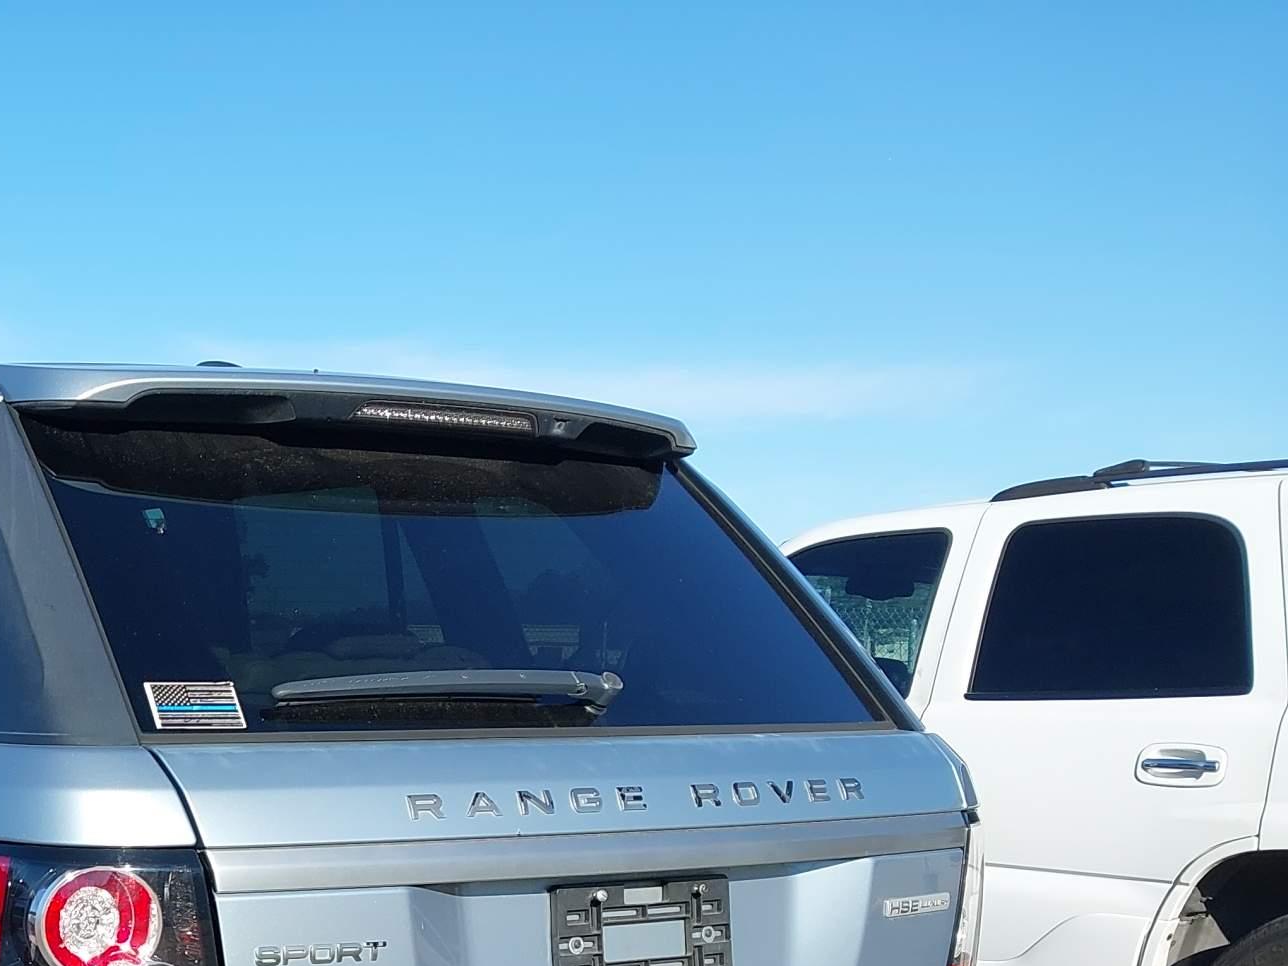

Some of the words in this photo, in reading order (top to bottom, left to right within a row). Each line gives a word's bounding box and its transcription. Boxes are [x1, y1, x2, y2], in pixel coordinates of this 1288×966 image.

[405, 785, 649, 821] RANGE
[689, 777, 866, 809] ROVER
[890, 900, 919, 915] HSE
